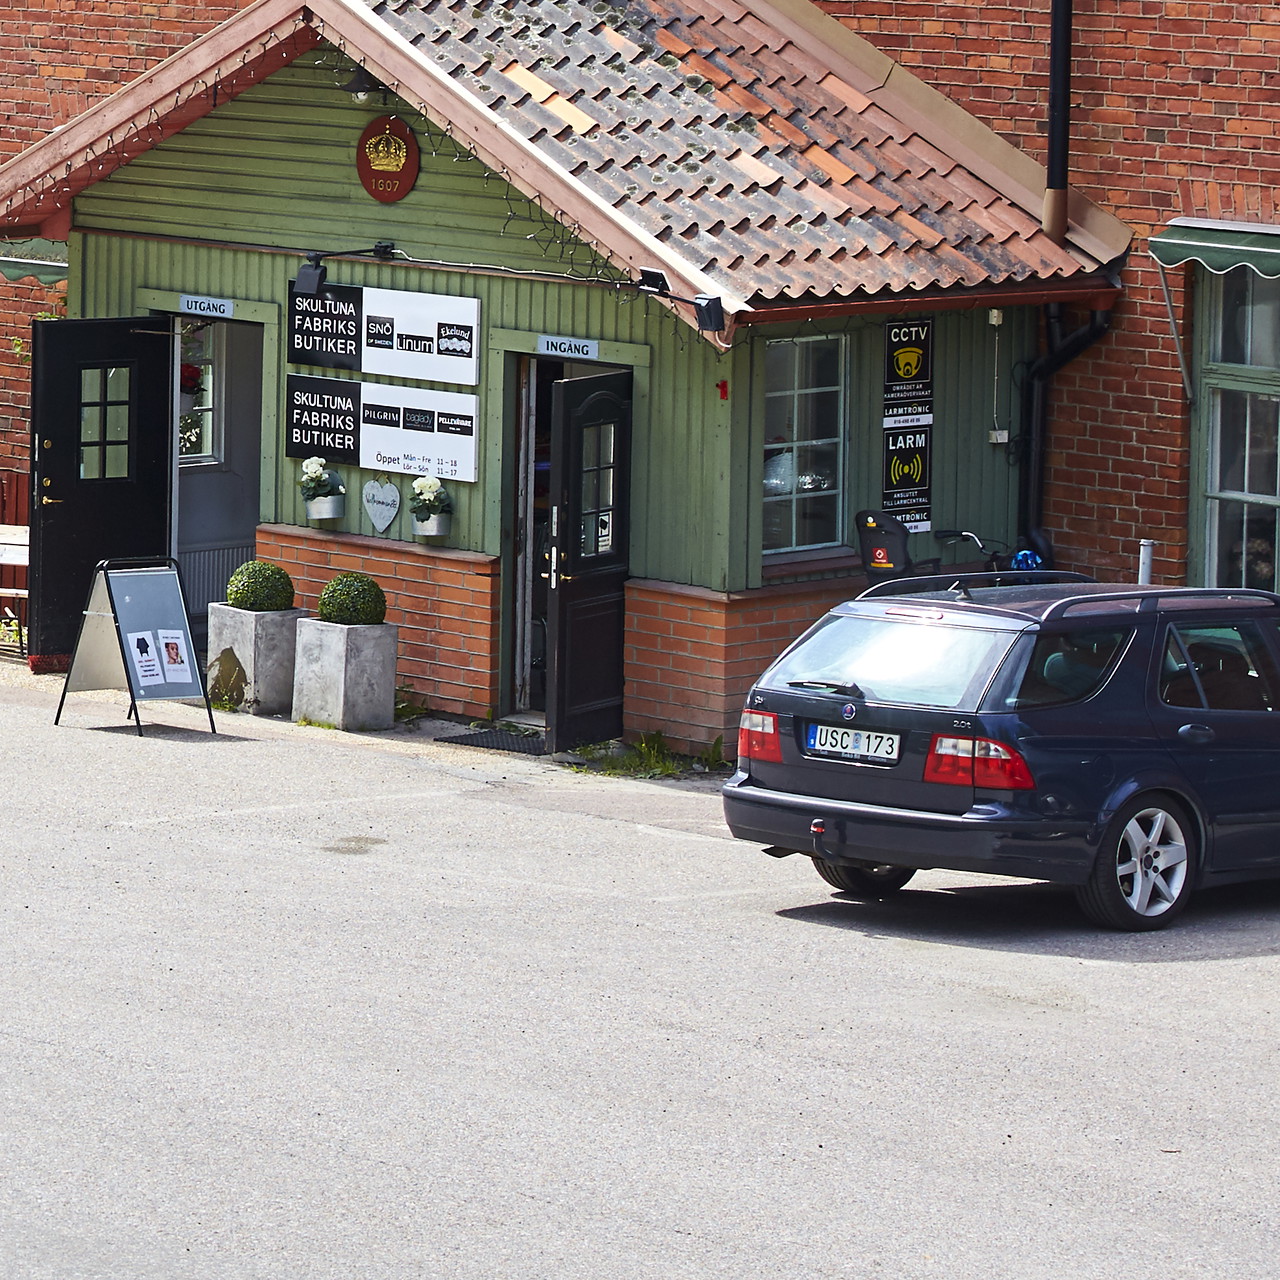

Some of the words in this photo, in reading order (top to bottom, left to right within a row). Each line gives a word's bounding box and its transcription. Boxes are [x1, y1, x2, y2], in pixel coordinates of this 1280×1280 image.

[371, 178, 400, 192] 1607
[186, 299, 226, 314] UTGÅNG
[295, 297, 356, 316] SKULTUNA
[295, 315, 356, 336] FABRIKS
[891, 326, 928, 342] CCTV
[294, 334, 356, 355] BUTIKER
[397, 334, 434, 353] Linum
[546, 340, 589, 356] INGÅNG
[293, 391, 354, 411] SKULTUNA
[364, 409, 399, 421] PILGRIM
[885, 405, 930, 416] LARMTRONIC
[293, 409, 354, 431] FABRIKS
[292, 428, 354, 450] BUTIKER
[888, 433, 926, 450] LARM
[376, 451, 400, 465] Öppet
[422, 455, 432, 464] Fre
[892, 512, 928, 522] MTRONIC
[819, 728, 850, 750] USC
[865, 734, 895, 755] 173
